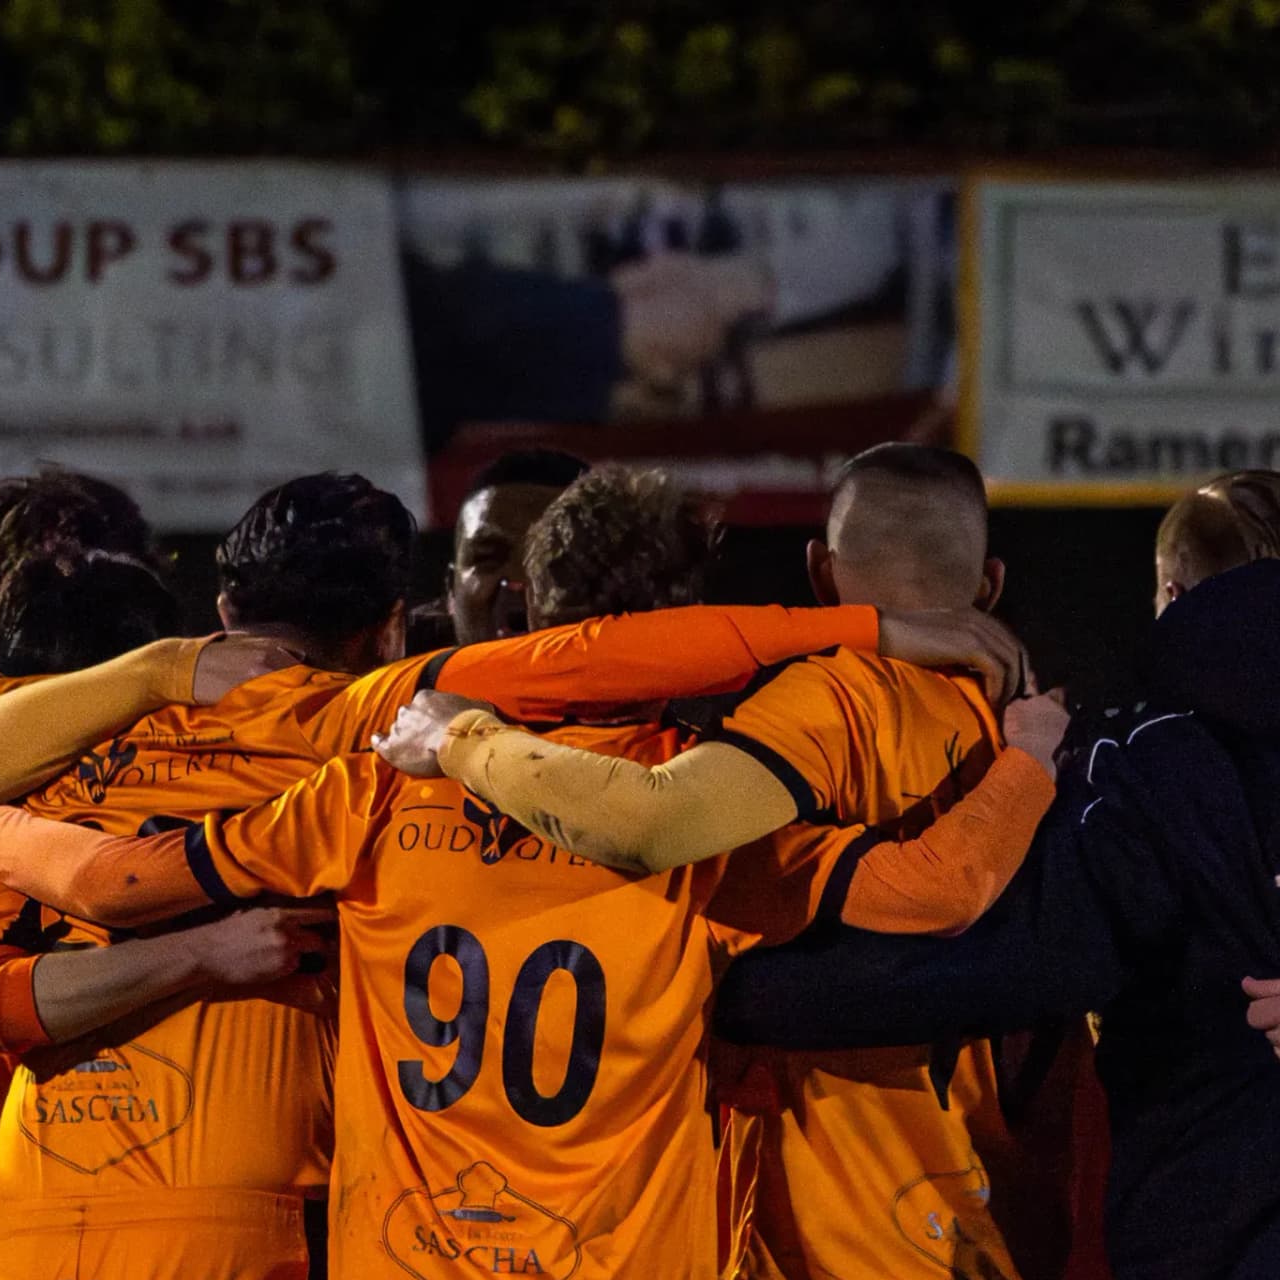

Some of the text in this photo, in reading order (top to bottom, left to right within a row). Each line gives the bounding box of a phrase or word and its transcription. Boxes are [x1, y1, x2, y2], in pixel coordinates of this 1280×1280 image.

[166, 217, 338, 285] SBS
[398, 822, 476, 852] OUD
[397, 924, 607, 1127] 90
